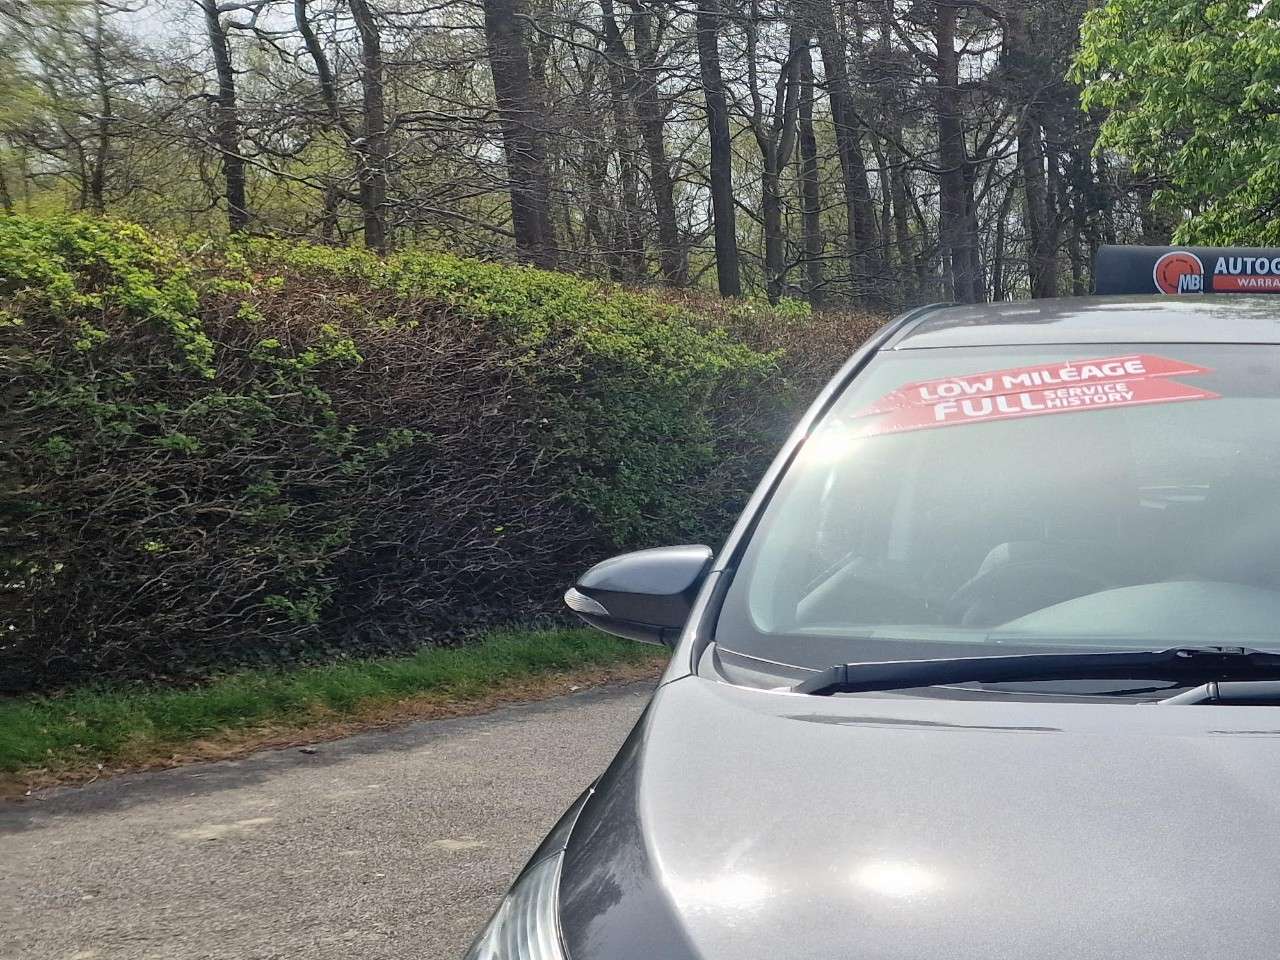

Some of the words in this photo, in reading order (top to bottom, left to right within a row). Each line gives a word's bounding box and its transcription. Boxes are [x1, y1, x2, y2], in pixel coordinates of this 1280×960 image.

[920, 377, 993, 401] LOW
[1003, 362, 1146, 388] MILEAGE
[1047, 390, 1134, 409] HISTORY
[934, 393, 1047, 421] FULL
[1044, 383, 1128, 399] SERVICE
